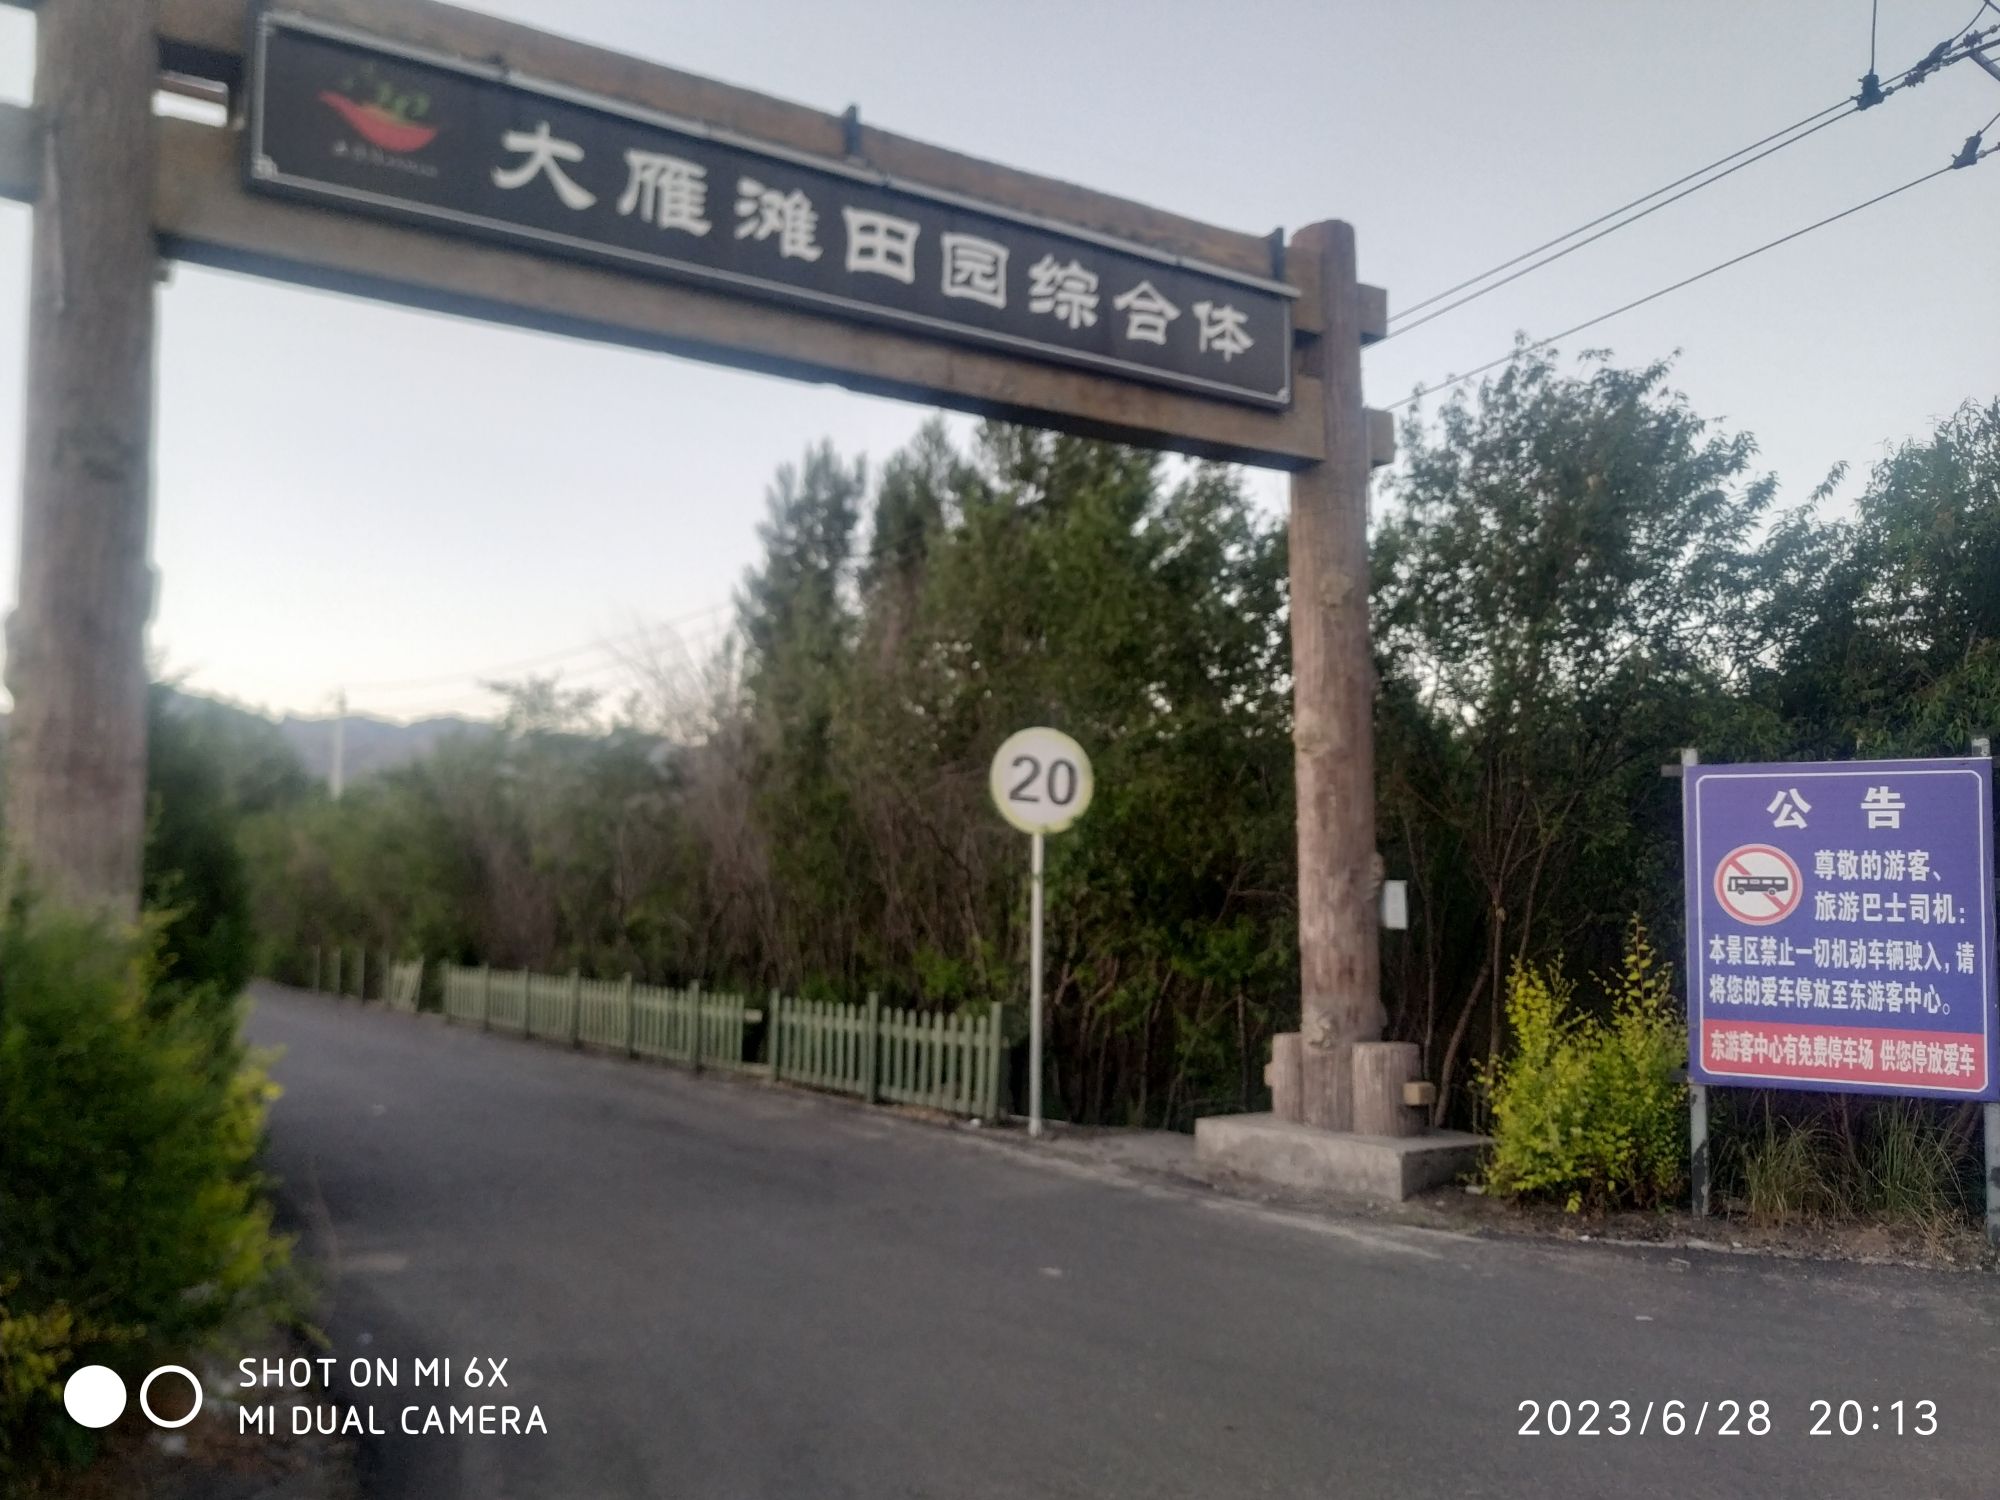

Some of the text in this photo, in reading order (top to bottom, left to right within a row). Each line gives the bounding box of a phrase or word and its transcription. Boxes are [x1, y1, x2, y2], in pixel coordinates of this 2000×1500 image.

[490, 119, 1256, 363] 大雁滩田园综合体
[1008, 754, 1078, 806] 20
[1813, 849, 1942, 882] 尊敬的游客、
[1710, 1028, 1874, 1071] 东游客中心有免费停车场
